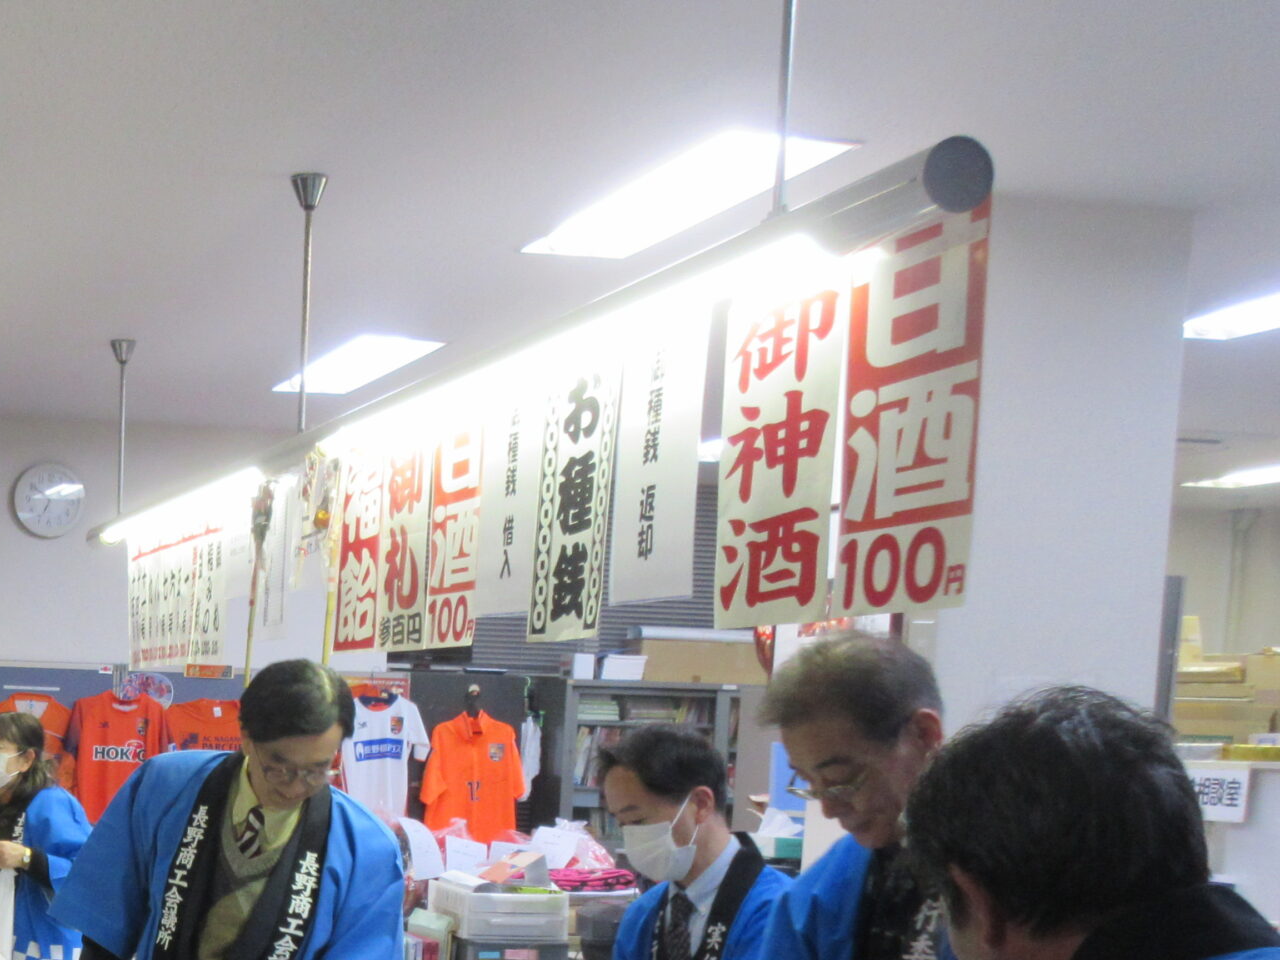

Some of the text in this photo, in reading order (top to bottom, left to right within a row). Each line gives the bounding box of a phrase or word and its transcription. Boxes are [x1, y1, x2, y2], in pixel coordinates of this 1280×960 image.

[844, 210, 989, 523] 甘酒
[549, 373, 603, 622] お種銭
[719, 287, 839, 612] 御神酒
[338, 456, 383, 644] 福飴
[498, 513, 515, 580] 借入
[637, 483, 657, 562] 返却
[840, 526, 966, 611] 100円
[427, 594, 476, 646] 100円
[1190, 777, 1241, 808] 相談室
[156, 805, 209, 951] 長野商工会議所
